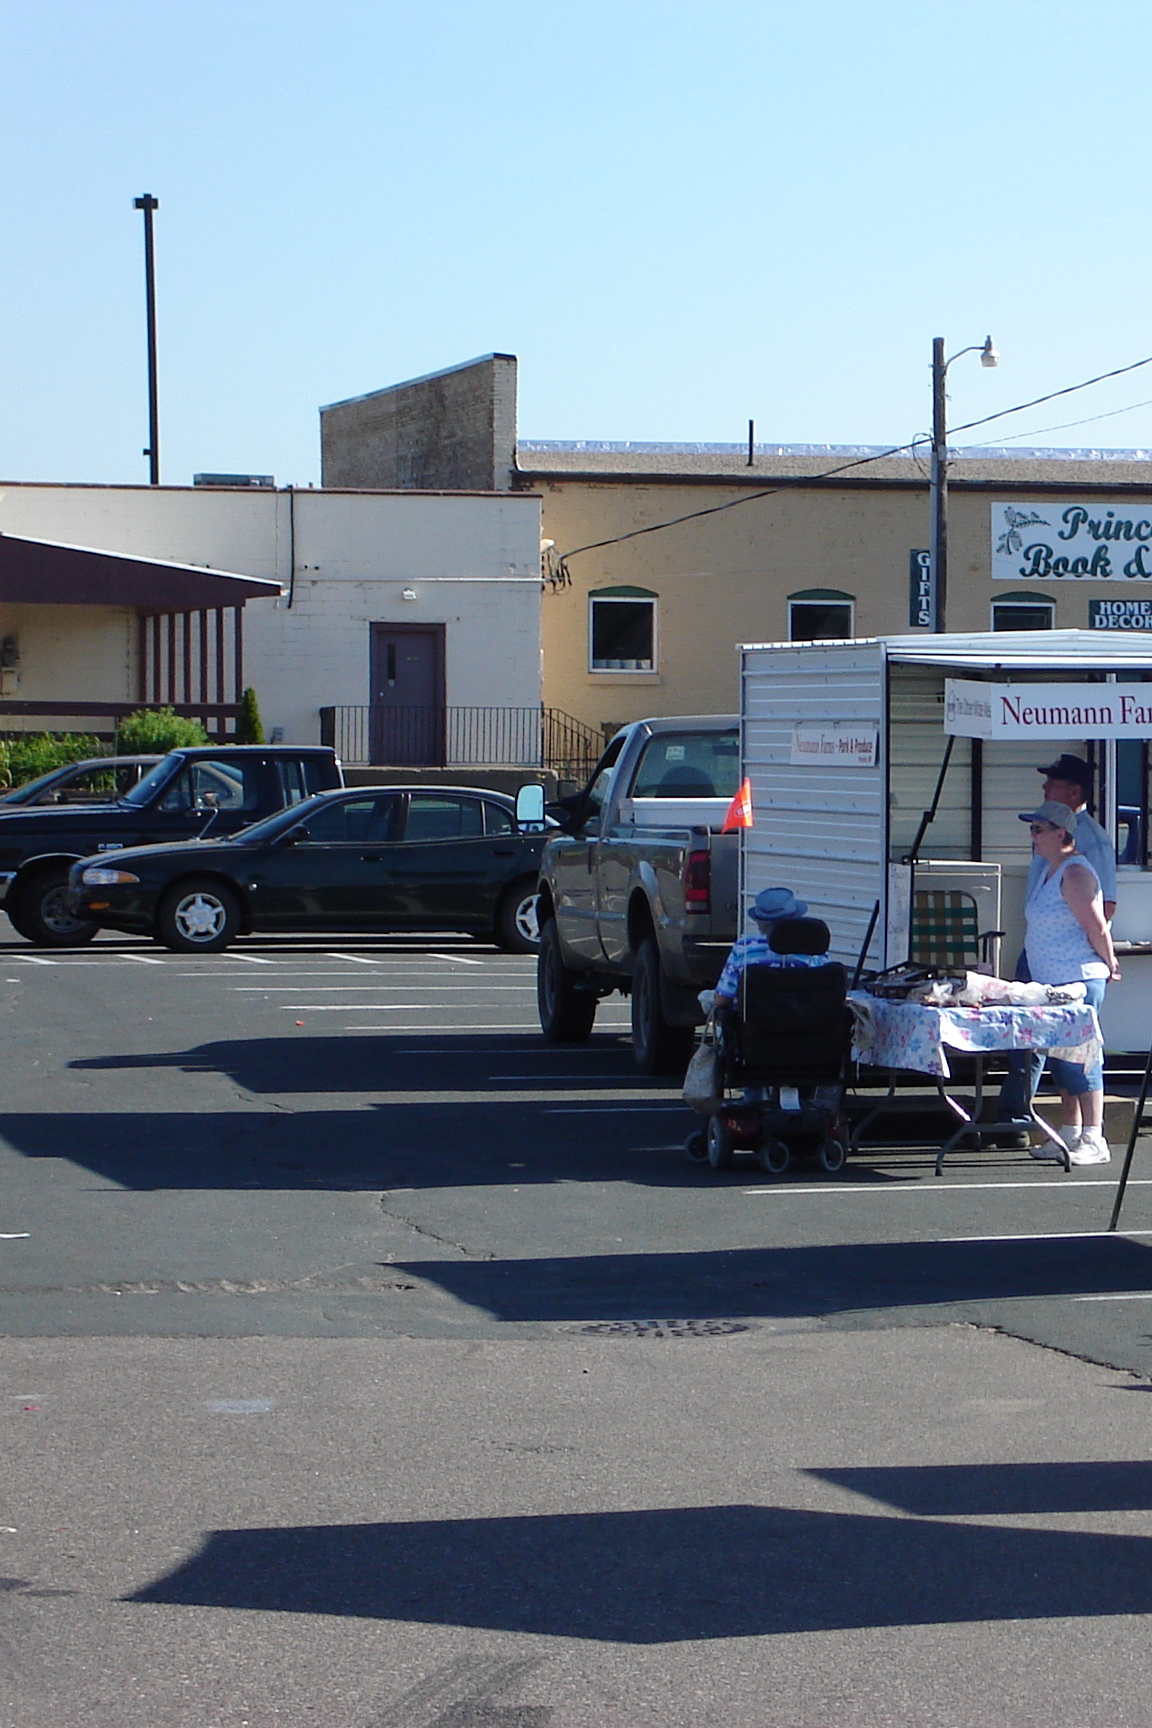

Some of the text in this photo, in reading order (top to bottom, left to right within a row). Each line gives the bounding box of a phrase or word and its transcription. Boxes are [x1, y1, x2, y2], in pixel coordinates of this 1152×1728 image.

[1019, 542, 1113, 578] Book
[1123, 545, 1152, 579] &
[915, 551, 930, 626] GIFTS
[1099, 601, 1151, 615] HOME
[1000, 695, 1114, 726] Neumann
